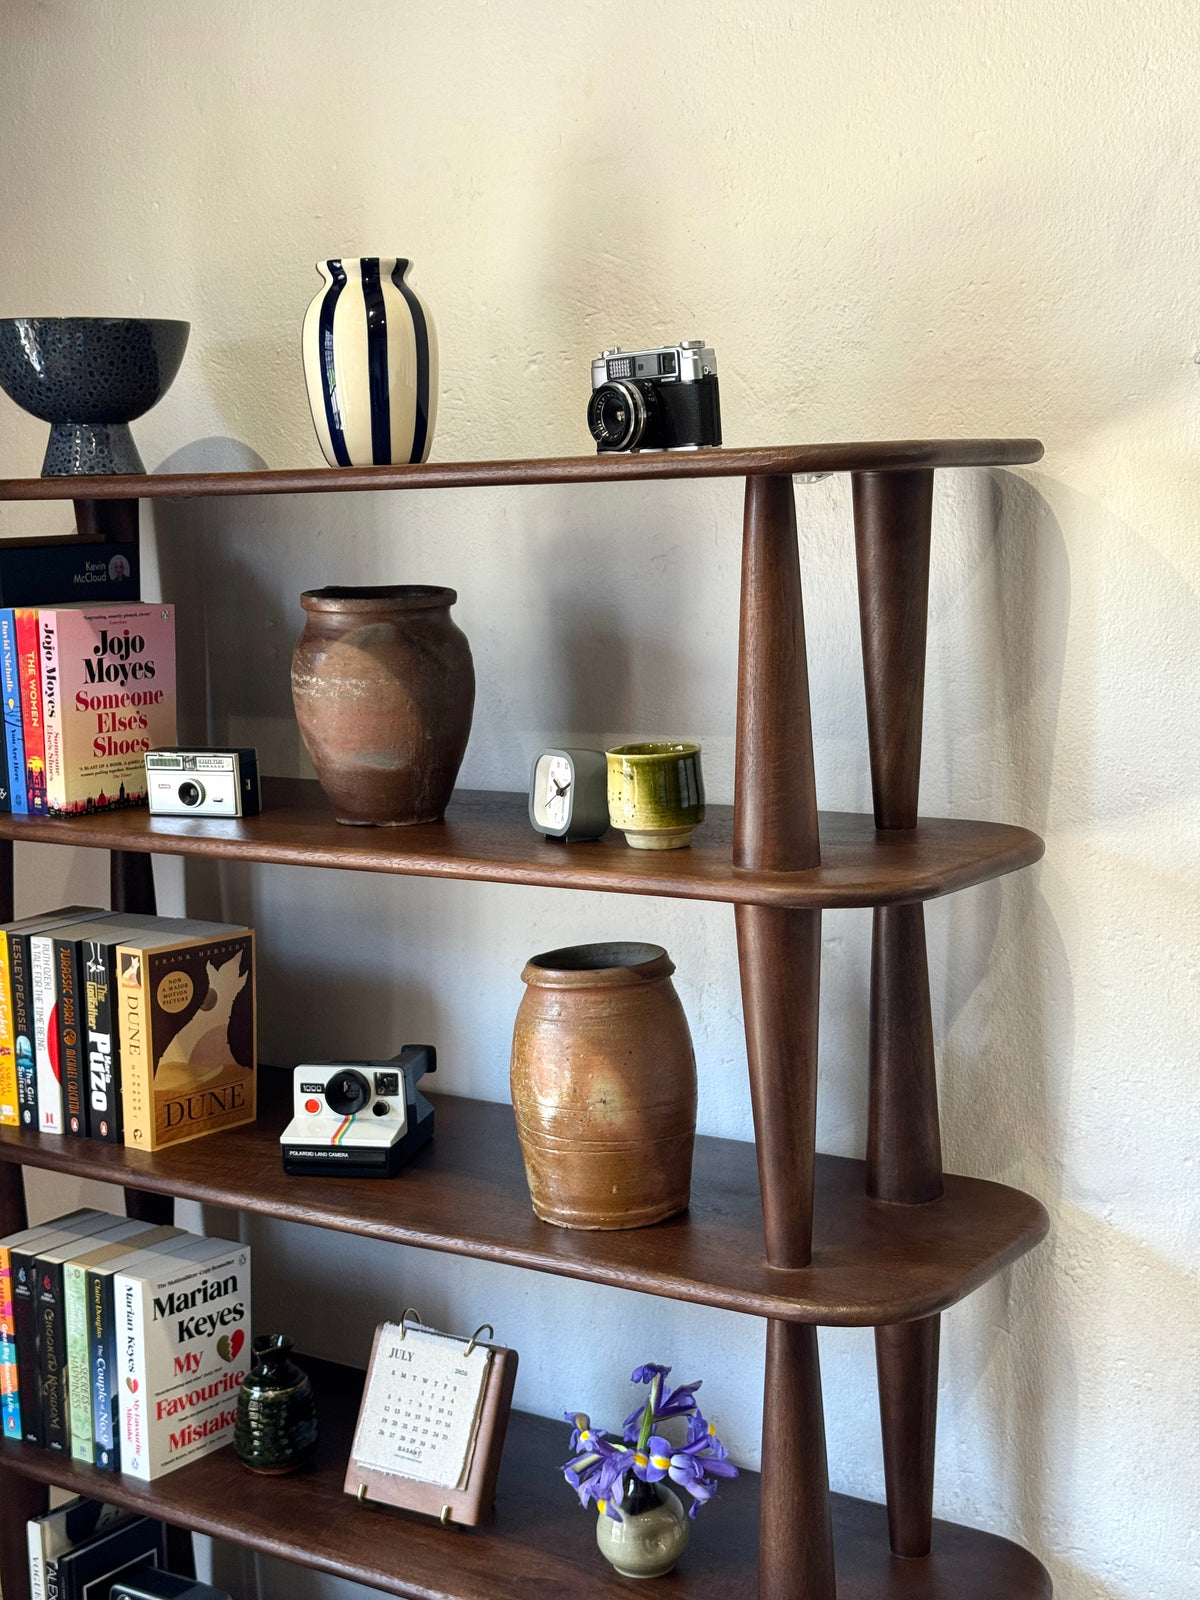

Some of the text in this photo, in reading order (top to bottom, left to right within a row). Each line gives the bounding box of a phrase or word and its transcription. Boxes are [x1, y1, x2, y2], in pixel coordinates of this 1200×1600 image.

[73, 572, 107, 584] McCloud
[85, 561, 107, 572] Kevin
[1, 620, 14, 693] David Nicholls
[93, 629, 145, 661] Jojo
[42, 623, 57, 718] Jojo Moyes
[81, 657, 156, 687] Moyes
[27, 651, 39, 727] THE WOMEN
[75, 689, 164, 713] Someone
[96, 710, 148, 734] Else's
[93, 735, 150, 758] Shoes
[33, 950, 42, 969] TALE
[42, 943, 52, 990] RUTH OZEKI
[154, 942, 247, 966] FRANK HERBERT
[12, 938, 26, 1032] LESLEY PEARSE
[34, 970, 43, 988] FOR
[97, 983, 108, 1002] The
[163, 990, 188, 999] MOTION
[168, 977, 182, 985] NOW
[168, 983, 188, 991] MAJOR
[35, 989, 43, 1004] THE
[86, 980, 99, 1030] Godfather
[162, 996, 188, 1006] PICTURE
[36, 1006, 44, 1024] TIME
[60, 947, 80, 1114] JURASSIC PARK MICHAEL CRICHTON
[127, 995, 141, 1056] DUNE
[36, 1026, 46, 1051] BEING
[25, 1067, 33, 1084] The
[104, 1055, 112, 1084] Mario
[27, 1086, 35, 1105] Girl
[302, 1084, 322, 1092] 1000
[164, 1083, 246, 1128] DUNE
[152, 1274, 239, 1322] Marian
[95, 1305, 103, 1339] Douglas
[125, 1284, 136, 1373] Marian Keyes
[177, 1302, 245, 1344] Keyes
[1, 1323, 14, 1413] Great Big Beautiful Life
[173, 1350, 204, 1377] My
[388, 1347, 416, 1362] JULY
[70, 1355, 81, 1409] HAPPINESS
[80, 1364, 89, 1405] SECRETS
[96, 1357, 107, 1403] Couple
[155, 1369, 245, 1421] Favourite
[133, 1398, 142, 1456] My Favourite
[168, 1406, 239, 1454] Mistake
[32, 1557, 42, 1600] VOGUE
[46, 1565, 59, 1600] ALEX
